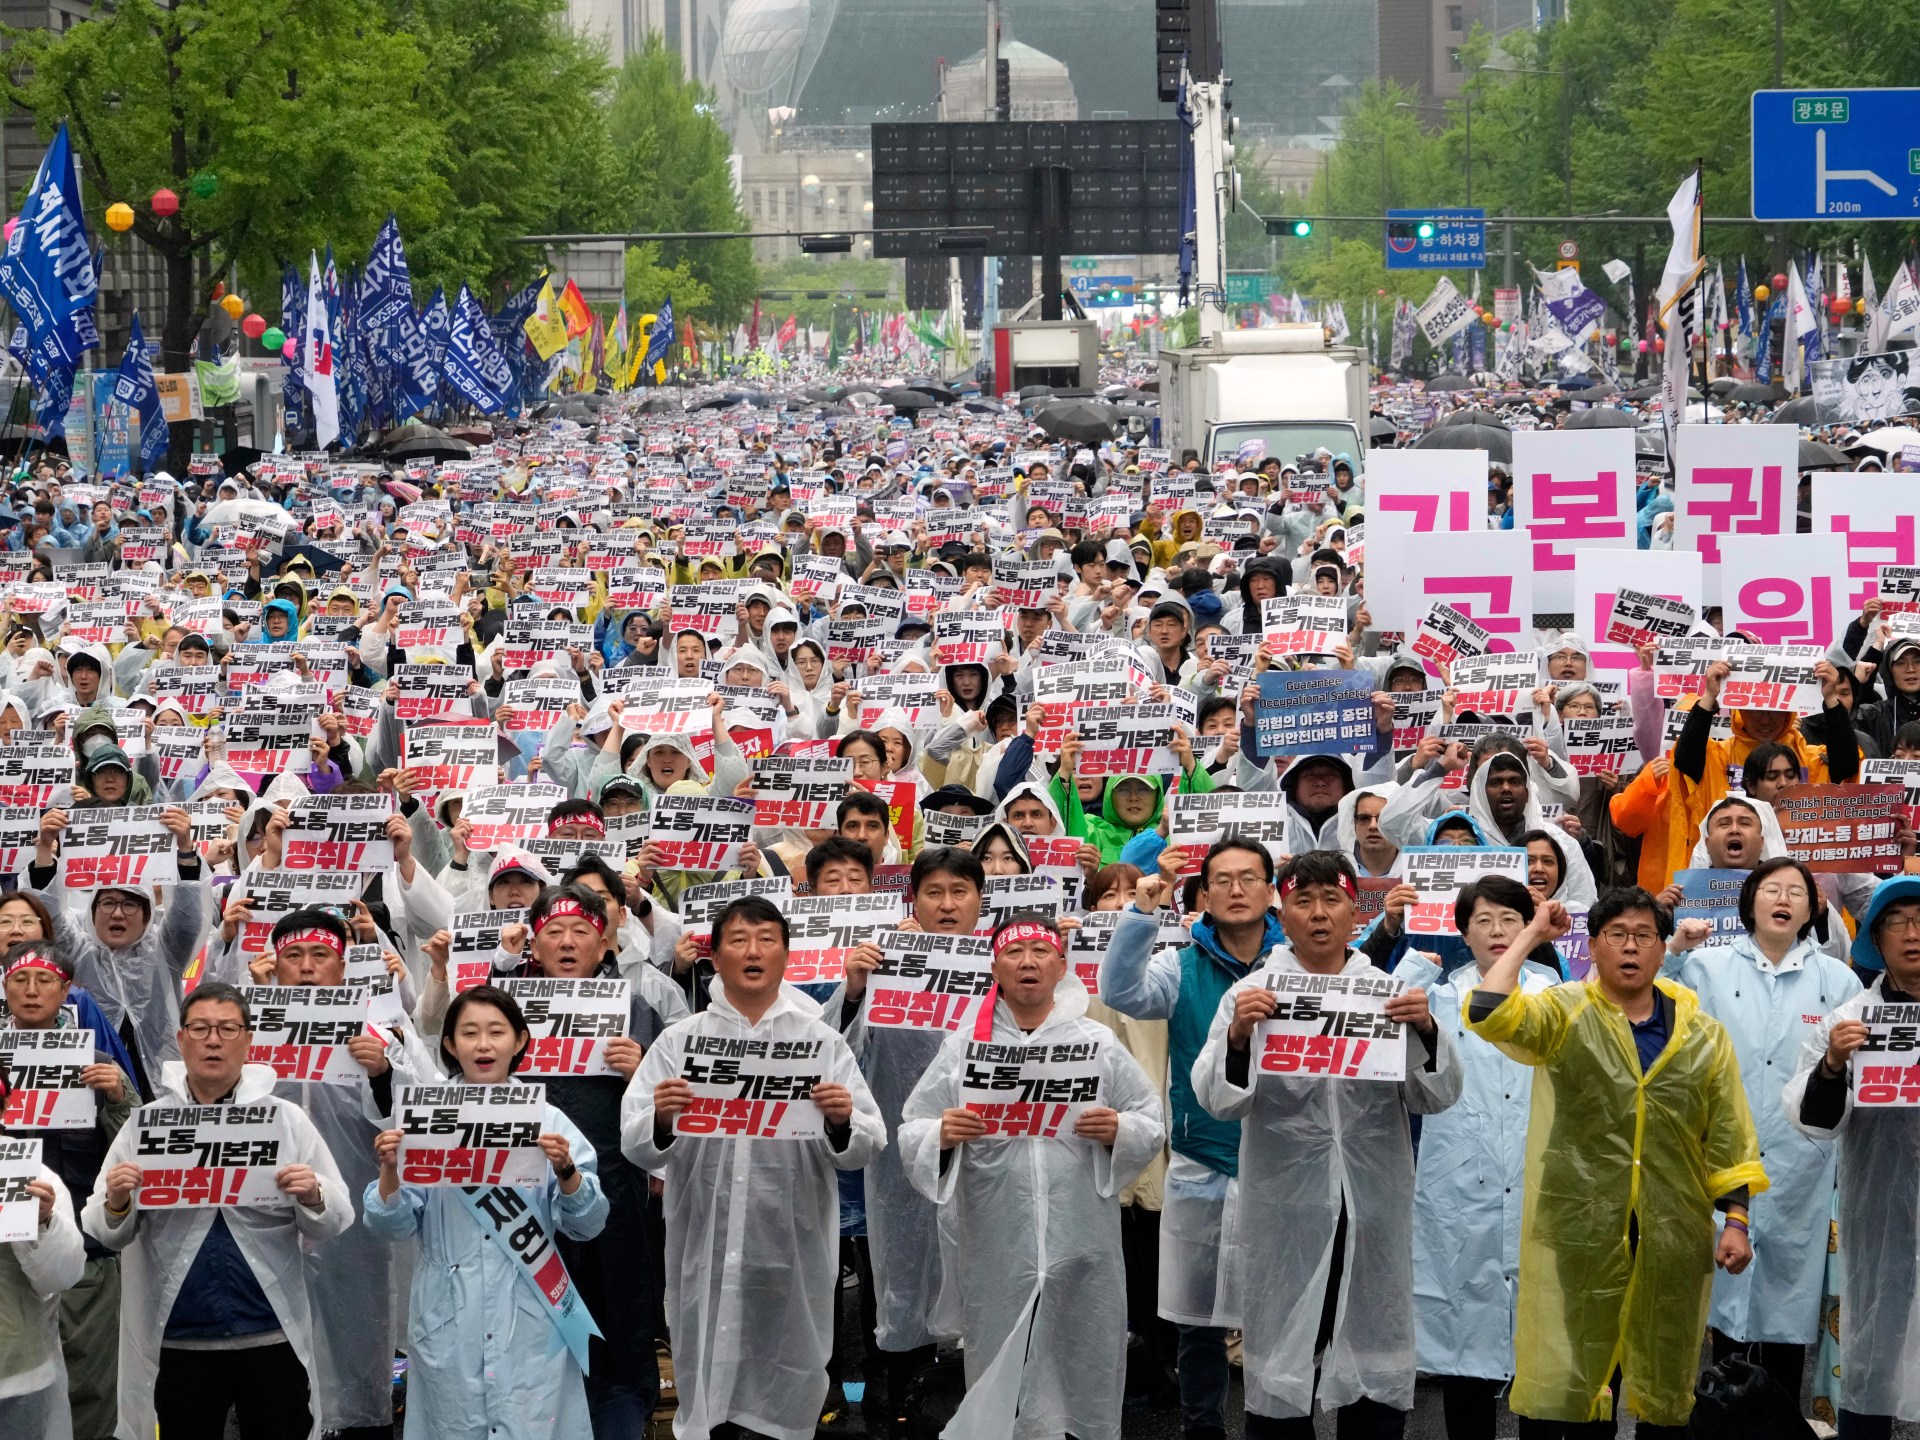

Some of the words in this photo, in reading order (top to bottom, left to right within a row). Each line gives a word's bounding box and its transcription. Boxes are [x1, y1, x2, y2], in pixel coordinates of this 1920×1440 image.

[1798, 102, 1844, 119] 광화문
[1829, 202, 1862, 213] 200m
[1562, 246, 1575, 254] 50
[1524, 470, 1624, 572] 본
[685, 527, 705, 536] 노동
[705, 532, 735, 541] 기본권
[684, 542, 723, 555] 쟁취!
[612, 568, 644, 576] 내란세력
[610, 576, 633, 587] 노동
[633, 582, 665, 592] 기본권
[612, 592, 654, 608] 쟁취!
[1265, 597, 1314, 611] 내란세력
[1316, 597, 1343, 609] 청산!
[1265, 609, 1298, 626] 노동
[1297, 617, 1344, 631] 기본권
[1267, 632, 1327, 653] 쟁취!
[1727, 645, 1780, 657] 내란세력
[1783, 646, 1818, 657] 청산!
[1728, 657, 1764, 672] 노동
[1762, 664, 1817, 684] 기본권
[1286, 678, 1342, 692] Guarantee
[1724, 681, 1797, 708] 쟁취!
[1260, 692, 1328, 709] Occupational
[1330, 688, 1372, 702] Safety!
[1078, 707, 1137, 721] 내란세력
[1141, 706, 1172, 718] 청산!
[1258, 714, 1296, 732] 위험의
[1300, 710, 1338, 727] 이주화
[1342, 707, 1373, 722] 중단!
[1079, 722, 1119, 740] 노동
[1118, 729, 1174, 748] 기본권
[1260, 727, 1338, 748] 산업안전대책
[1340, 723, 1372, 739] 마련!
[751, 759, 808, 772] 내란세력
[811, 759, 849, 772] 청산!
[1080, 748, 1154, 775] 쟁취!
[751, 773, 792, 791] 노동
[790, 782, 848, 801] 기본권
[290, 795, 347, 810] 내란세력
[350, 795, 386, 810] 청산!
[655, 796, 712, 811] 내란세력
[715, 800, 754, 814] 청산!
[1823, 796, 1864, 808] Forced
[1866, 792, 1902, 806] Labor!
[66, 806, 128, 825] 내란세력
[754, 800, 827, 828] 쟁취!
[1790, 809, 1818, 822] Free
[1820, 808, 1842, 820] Job
[1843, 806, 1890, 819] Change!
[289, 811, 327, 831] 노동
[326, 822, 388, 841] 기본권
[652, 811, 696, 830] 노동
[692, 823, 750, 843] 기본권
[1784, 826, 1852, 846] 강제노동
[1856, 822, 1896, 840] 철폐!
[63, 826, 108, 847] 노동
[106, 832, 173, 855] 기본권
[284, 840, 366, 870] 쟁취!
[658, 841, 729, 870] 쟁취!
[1408, 854, 1477, 870] 내란세력
[1480, 854, 1521, 869] 청산!
[1812, 848, 1848, 862] 이동의
[1850, 846, 1872, 858] 자유
[1874, 844, 1901, 857] 보장!
[64, 856, 148, 887] 쟁취!
[1710, 880, 1744, 890] Guara
[1679, 896, 1738, 909] Occupatio
[880, 933, 954, 954] 내란세력
[871, 952, 928, 977] 노동
[924, 969, 994, 996] 기본권
[1266, 973, 1349, 995] 내란세력
[1351, 977, 1405, 998] 청산!
[241, 984, 310, 1006] 내란세력
[314, 985, 363, 1006] 청산!
[499, 980, 575, 998] 내란세력
[577, 981, 626, 999] 청산!
[868, 989, 972, 1031] 쟁취!
[1272, 995, 1322, 1021] 노동
[1319, 1011, 1401, 1039] 기본권
[282, 1021, 363, 1044] 기본권
[546, 1013, 626, 1037] 기본권
[683, 1036, 766, 1059] 내란세력
[770, 1040, 823, 1059] 청산!
[966, 1042, 1049, 1063] 내란세력
[1052, 1042, 1099, 1062] 청산!
[1261, 1034, 1372, 1076] 쟁취!
[681, 1056, 740, 1084] 노동
[737, 1075, 821, 1101] 기본권
[962, 1064, 1021, 1090] 노동
[1017, 1076, 1100, 1103] 기본권
[401, 1086, 485, 1106] 내란세력
[490, 1085, 541, 1105] 청산!
[138, 1106, 220, 1127] 내란세력
[226, 1105, 278, 1125] 청산!
[681, 1097, 788, 1138] 쟁취!
[966, 1102, 1069, 1137] 쟁취!
[401, 1109, 460, 1135] 노동
[456, 1122, 542, 1148] 기본권
[137, 1129, 196, 1156] 노동
[191, 1140, 280, 1167] 기본권
[402, 1147, 510, 1185] 쟁취!
[139, 1167, 248, 1206] 쟁취!
